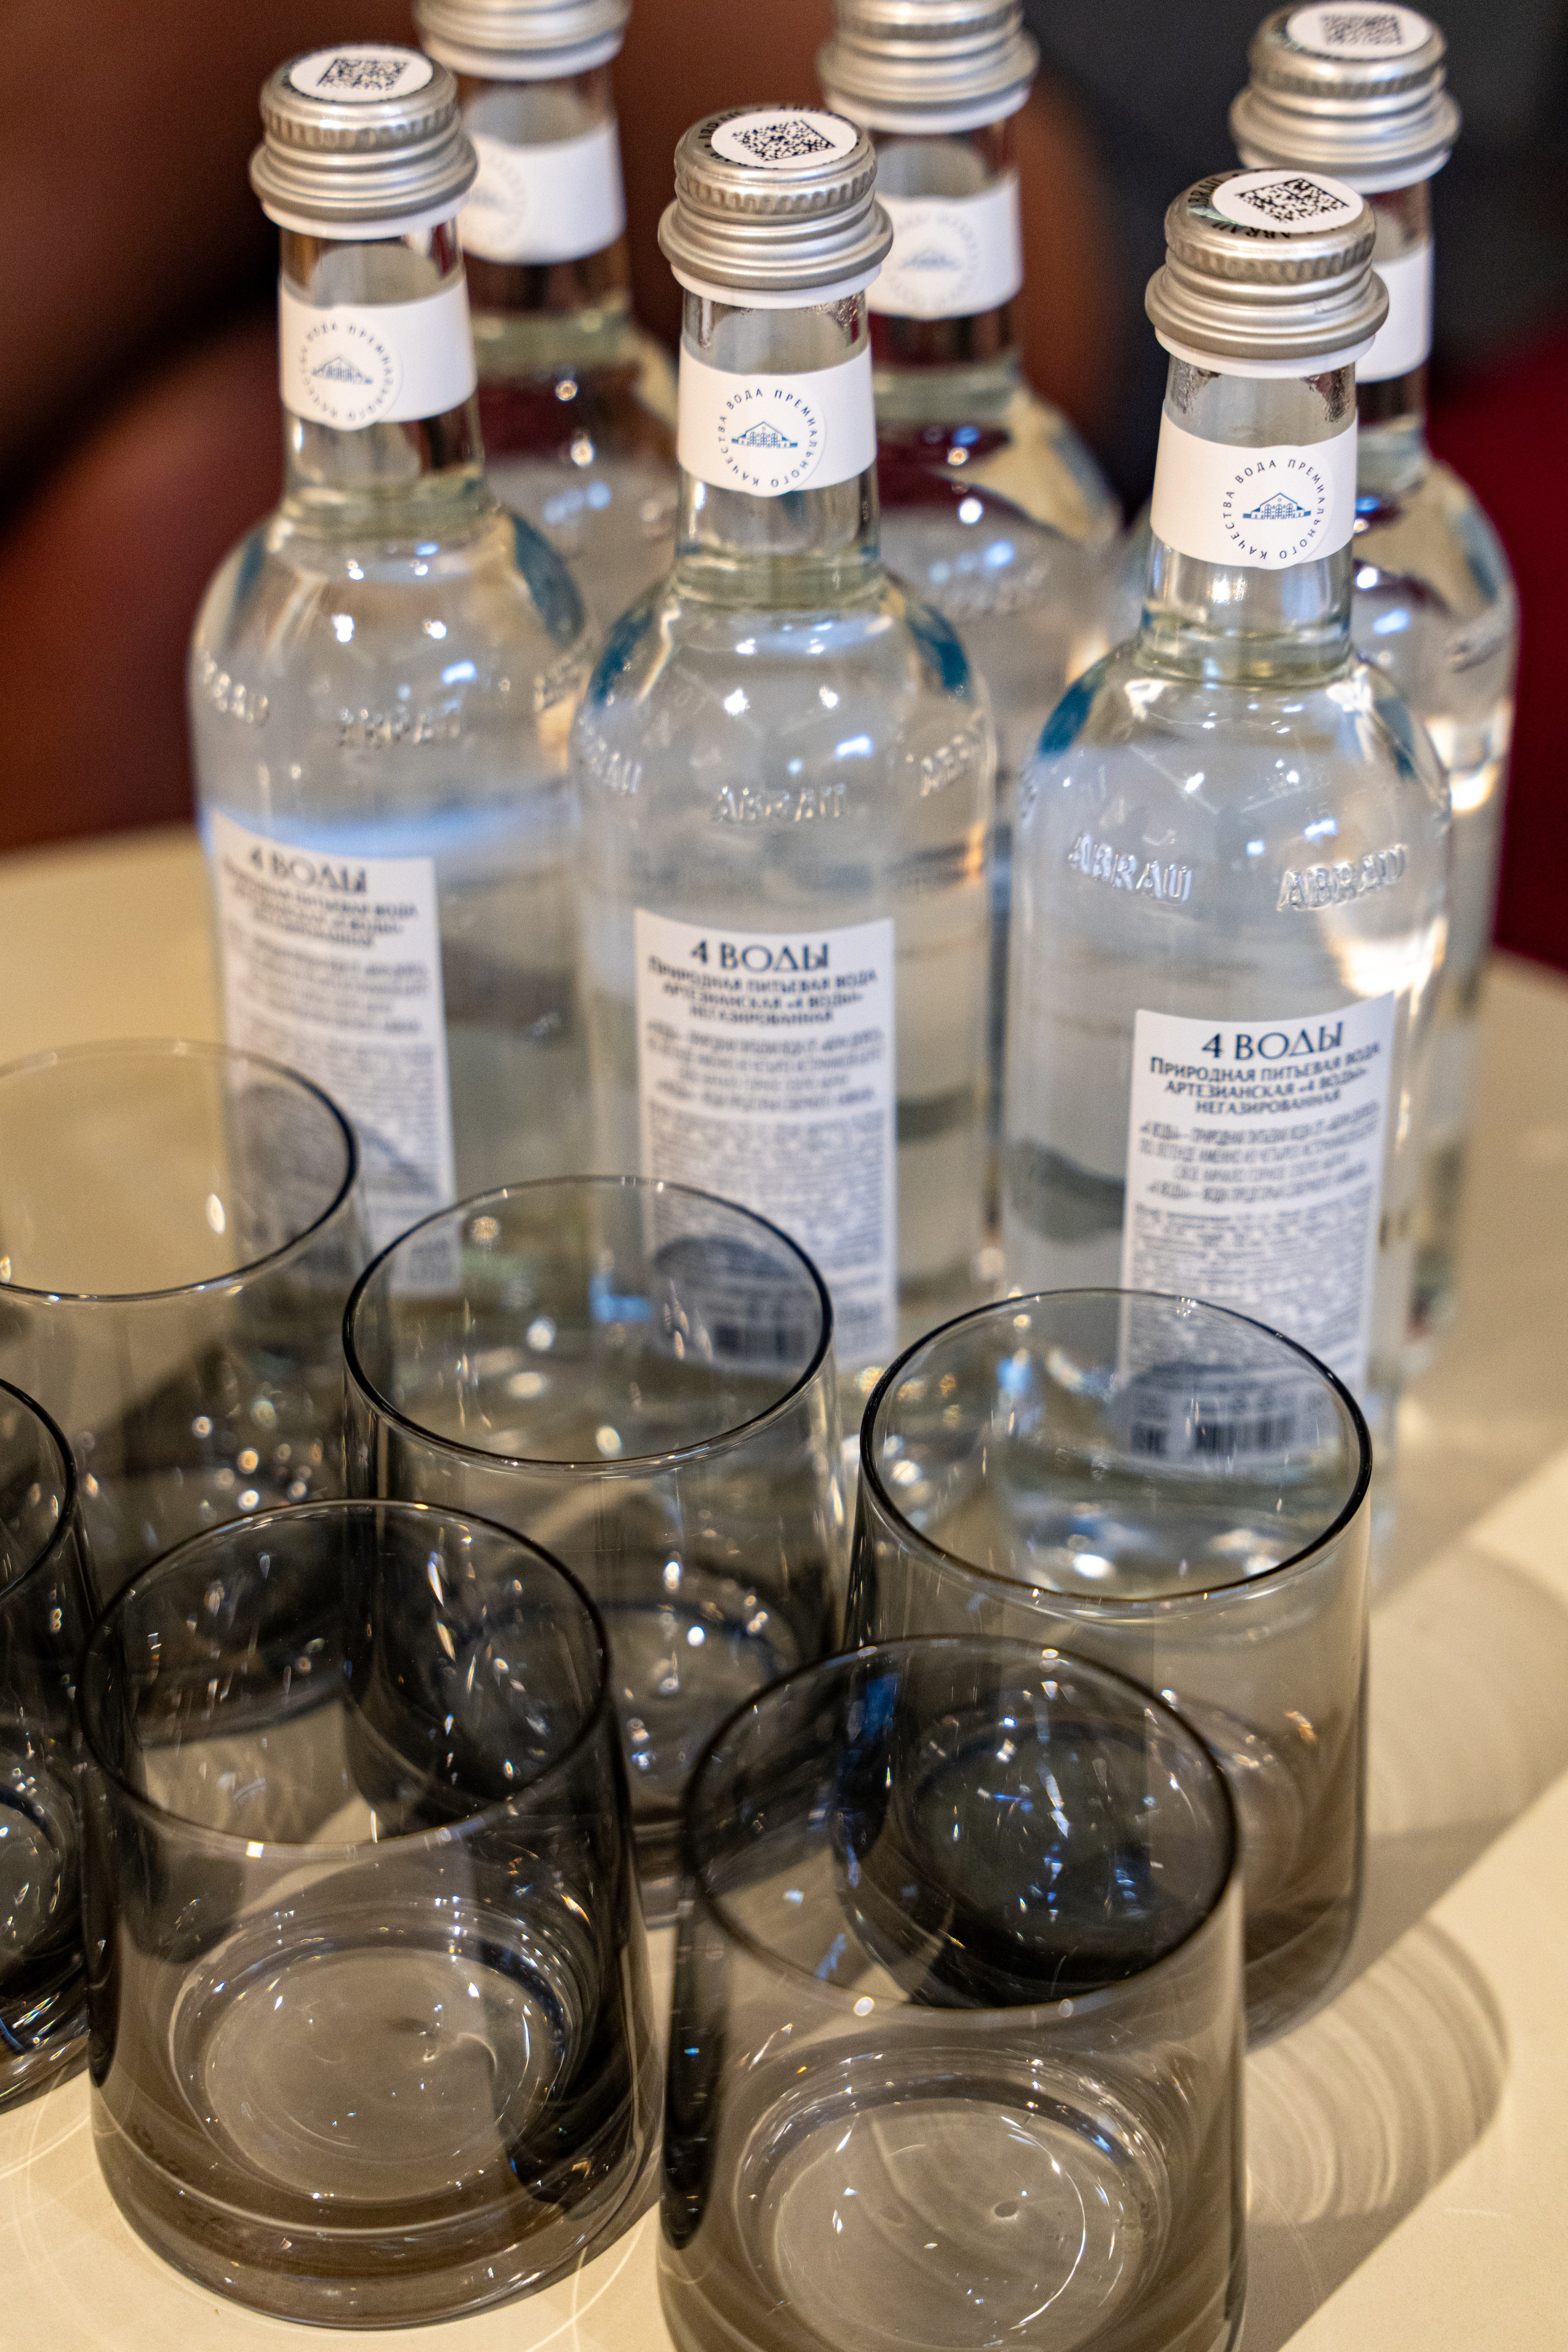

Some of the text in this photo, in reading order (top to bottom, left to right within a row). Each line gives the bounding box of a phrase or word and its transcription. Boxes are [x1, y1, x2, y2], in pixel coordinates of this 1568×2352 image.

[718, 388, 818, 488] ВОДА ПРЕМИАЛЬНОГО КАЧЕСТВА
[1223, 459, 1325, 559] ВОДА ПРЕМИАЛЬНОГО КАЧЕСТВА
[690, 940, 829, 973] 4 ВОДЫ
[1202, 1021, 1344, 1061] 4 ВОДЫ
[1261, 1056, 1341, 1082] ПИТЬЕВАЯ
[1164, 1080, 1295, 1100] АРТЕЗИАНСКАЯ
[1195, 1090, 1341, 1115] НЕГАЗИРОВАННАЯ
